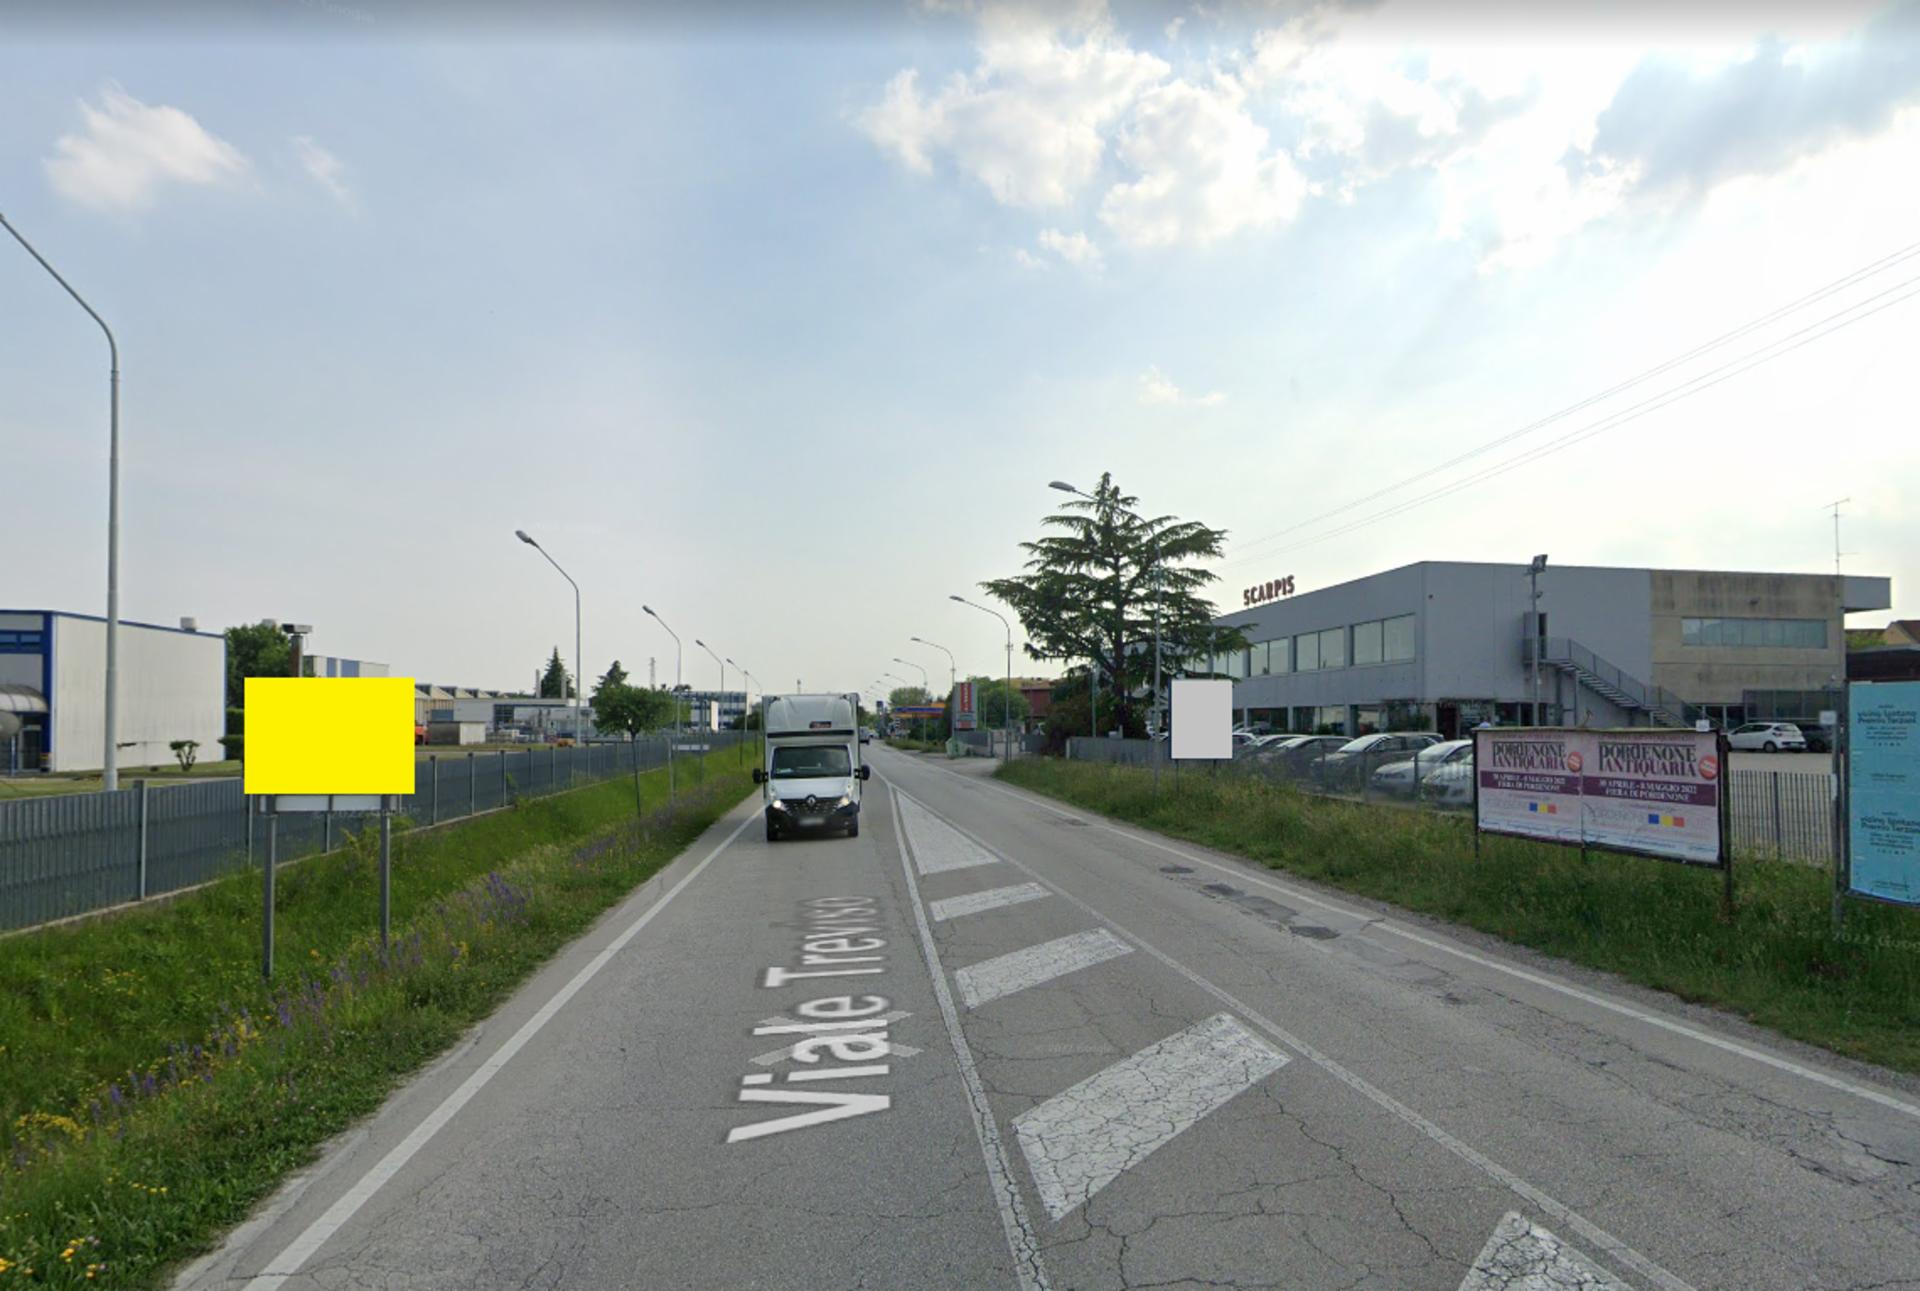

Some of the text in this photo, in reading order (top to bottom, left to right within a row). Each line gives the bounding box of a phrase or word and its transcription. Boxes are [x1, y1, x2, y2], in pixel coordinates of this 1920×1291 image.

[1243, 574, 1295, 606] SCARPIS
[1497, 753, 1566, 771] ANTIQUARIA
[1606, 757, 1697, 778] ANTIQUARIA
[1605, 787, 1628, 797] FIERA
[1640, 790, 1690, 802] PORDENONE
[1608, 780, 1635, 789] APRILE
[1646, 783, 1680, 793] MAGGIO
